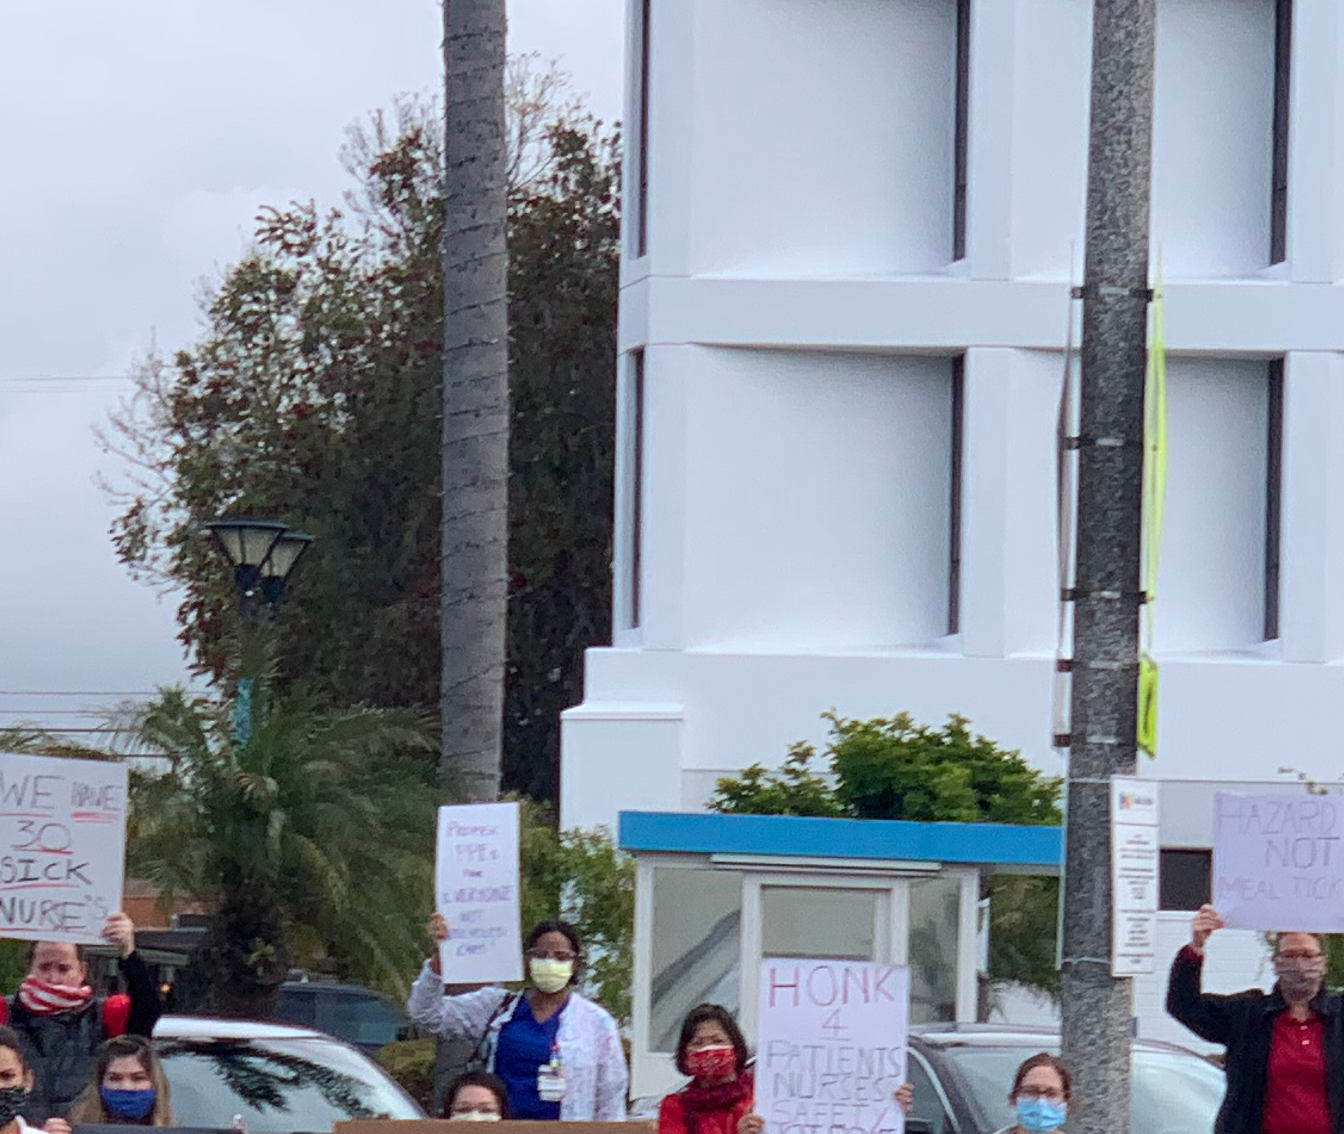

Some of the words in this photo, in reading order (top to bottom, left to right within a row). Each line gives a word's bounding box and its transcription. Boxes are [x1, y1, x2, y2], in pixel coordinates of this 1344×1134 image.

[1216, 798, 1336, 835] HAZARD
[9, 820, 71, 851] 30
[1265, 836, 1340, 869] NOT
[1218, 876, 1281, 900] MEAL
[768, 965, 895, 1008] HONK
[820, 1008, 850, 1038] 4
[767, 1039, 901, 1079] PATIENTS
[773, 1073, 888, 1102] NURSES
[770, 1100, 889, 1134] SAFETY
